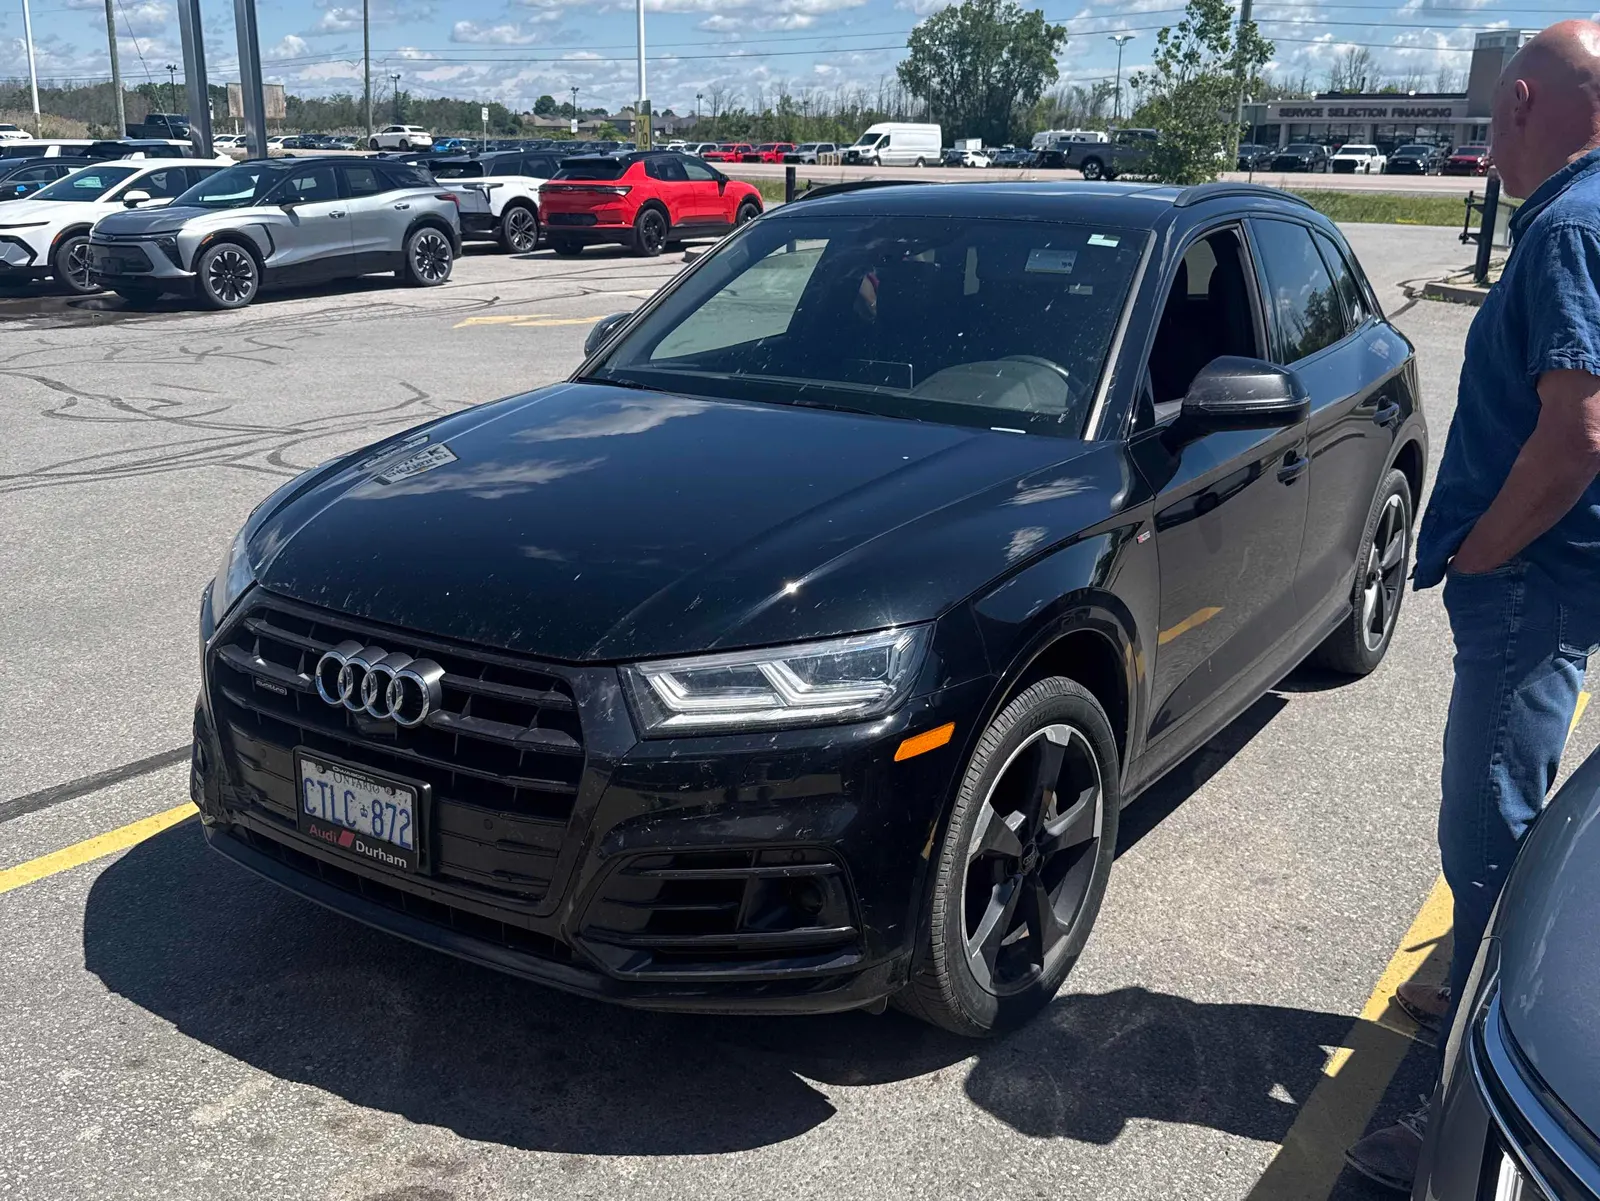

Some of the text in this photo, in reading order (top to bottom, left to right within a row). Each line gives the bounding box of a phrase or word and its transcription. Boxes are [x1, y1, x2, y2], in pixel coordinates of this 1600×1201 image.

[1279, 107, 1452, 118] SERVICE SELECTION FINANCING
[333, 772, 380, 794] ONTARIO
[304, 777, 411, 849] CTLC 872
[309, 824, 407, 868] Audi Durham
